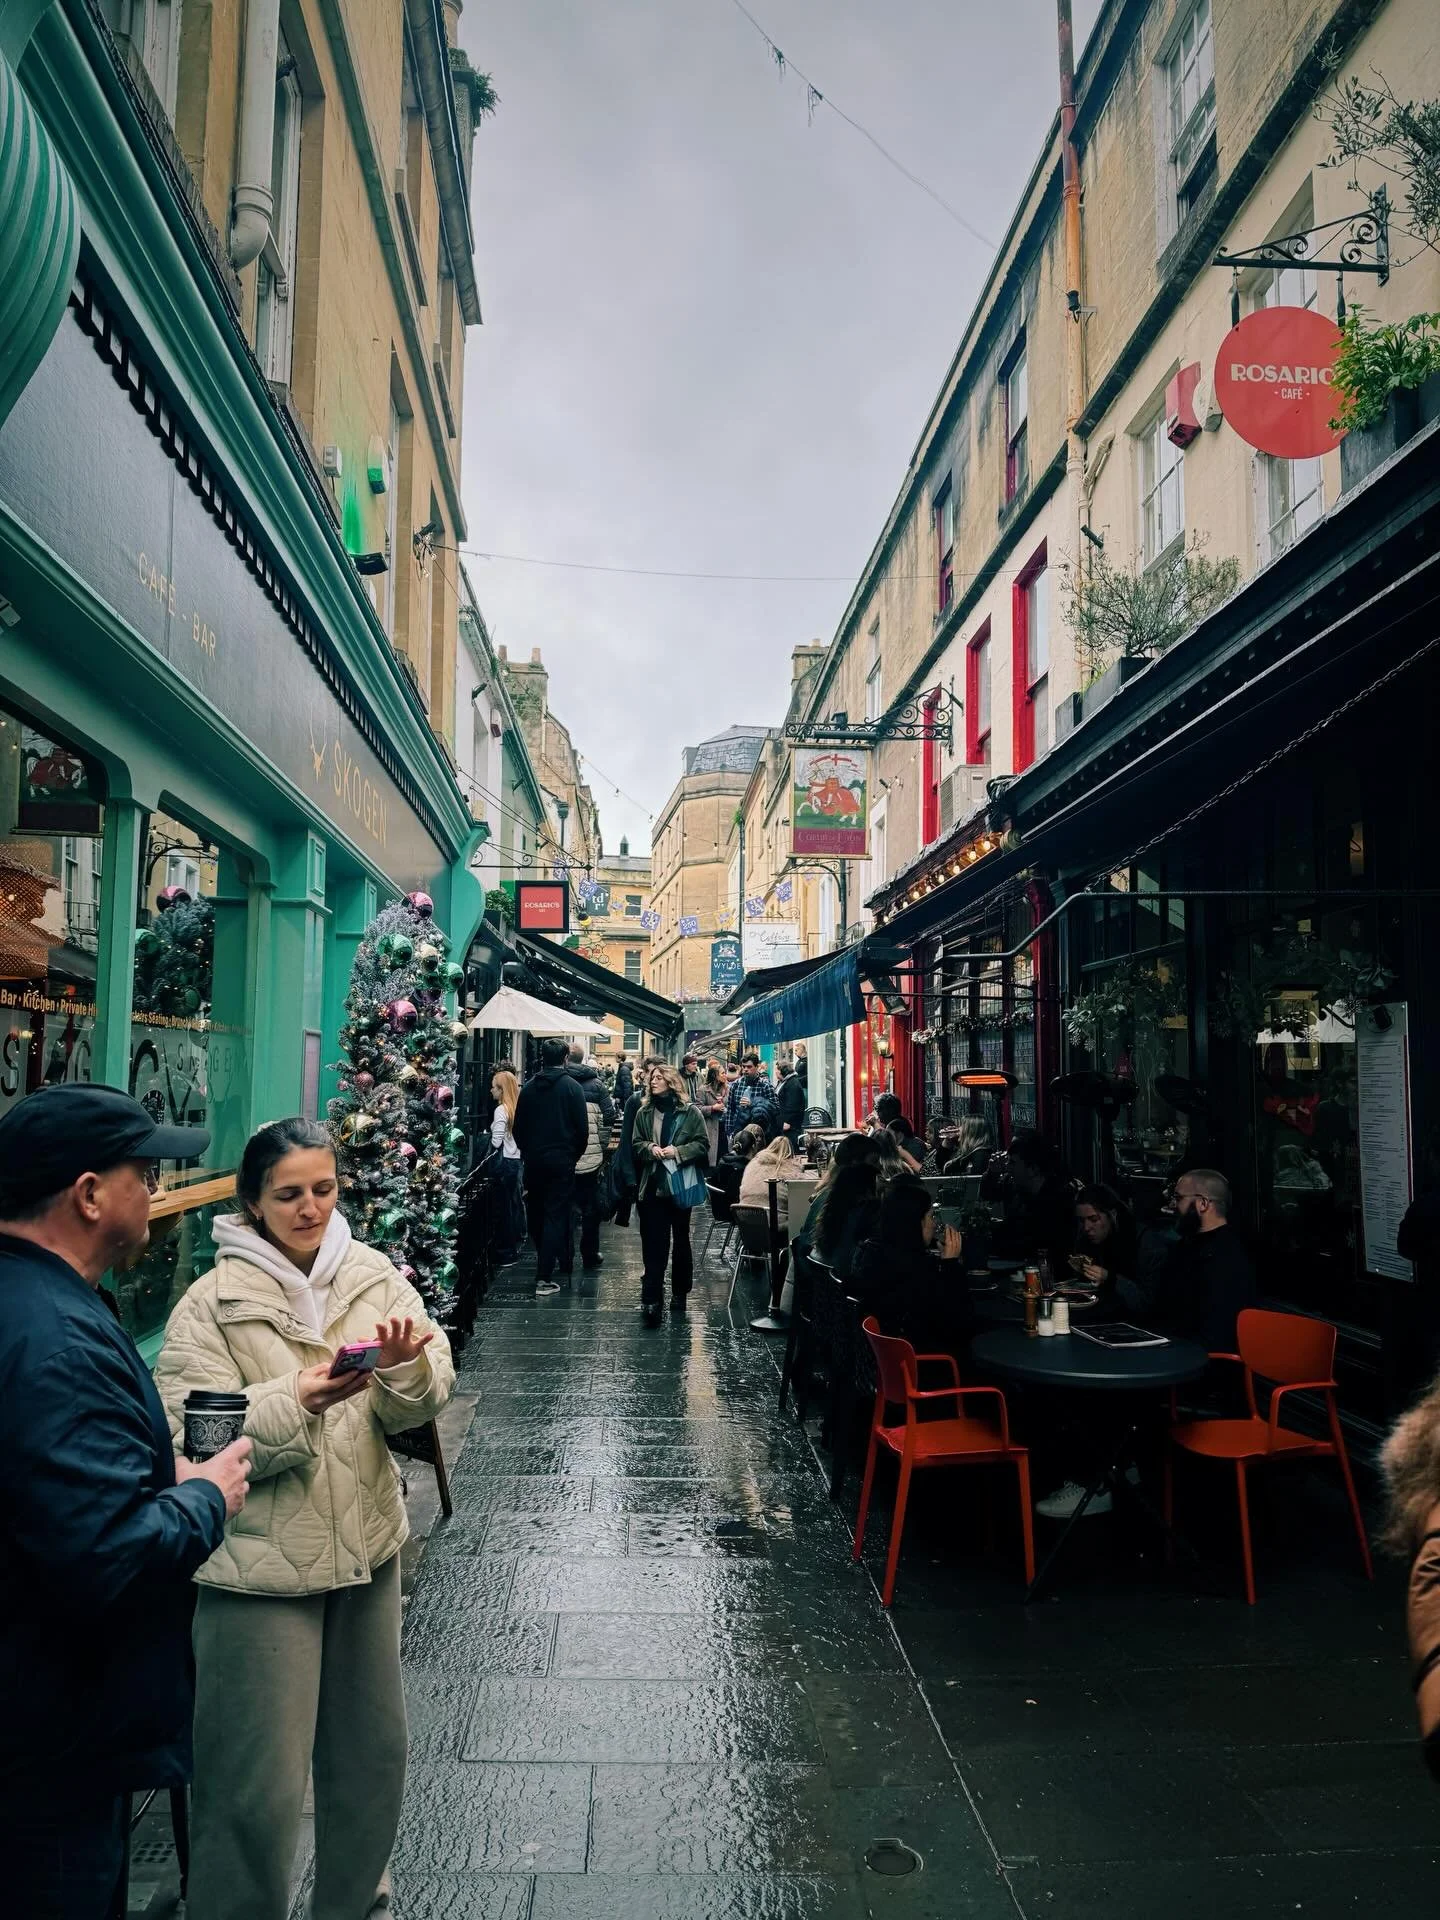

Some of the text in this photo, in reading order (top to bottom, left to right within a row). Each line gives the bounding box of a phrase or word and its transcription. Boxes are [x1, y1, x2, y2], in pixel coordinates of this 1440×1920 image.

[1281, 387, 1303, 400] CAFÉ
[192, 611, 216, 660] BAR
[333, 739, 388, 848] SKOGEN
[713, 962, 742, 970] WYLDE
[1, 988, 17, 1006] Bar
[23, 992, 55, 1012] Kitchen
[60, 998, 87, 1015] Private
